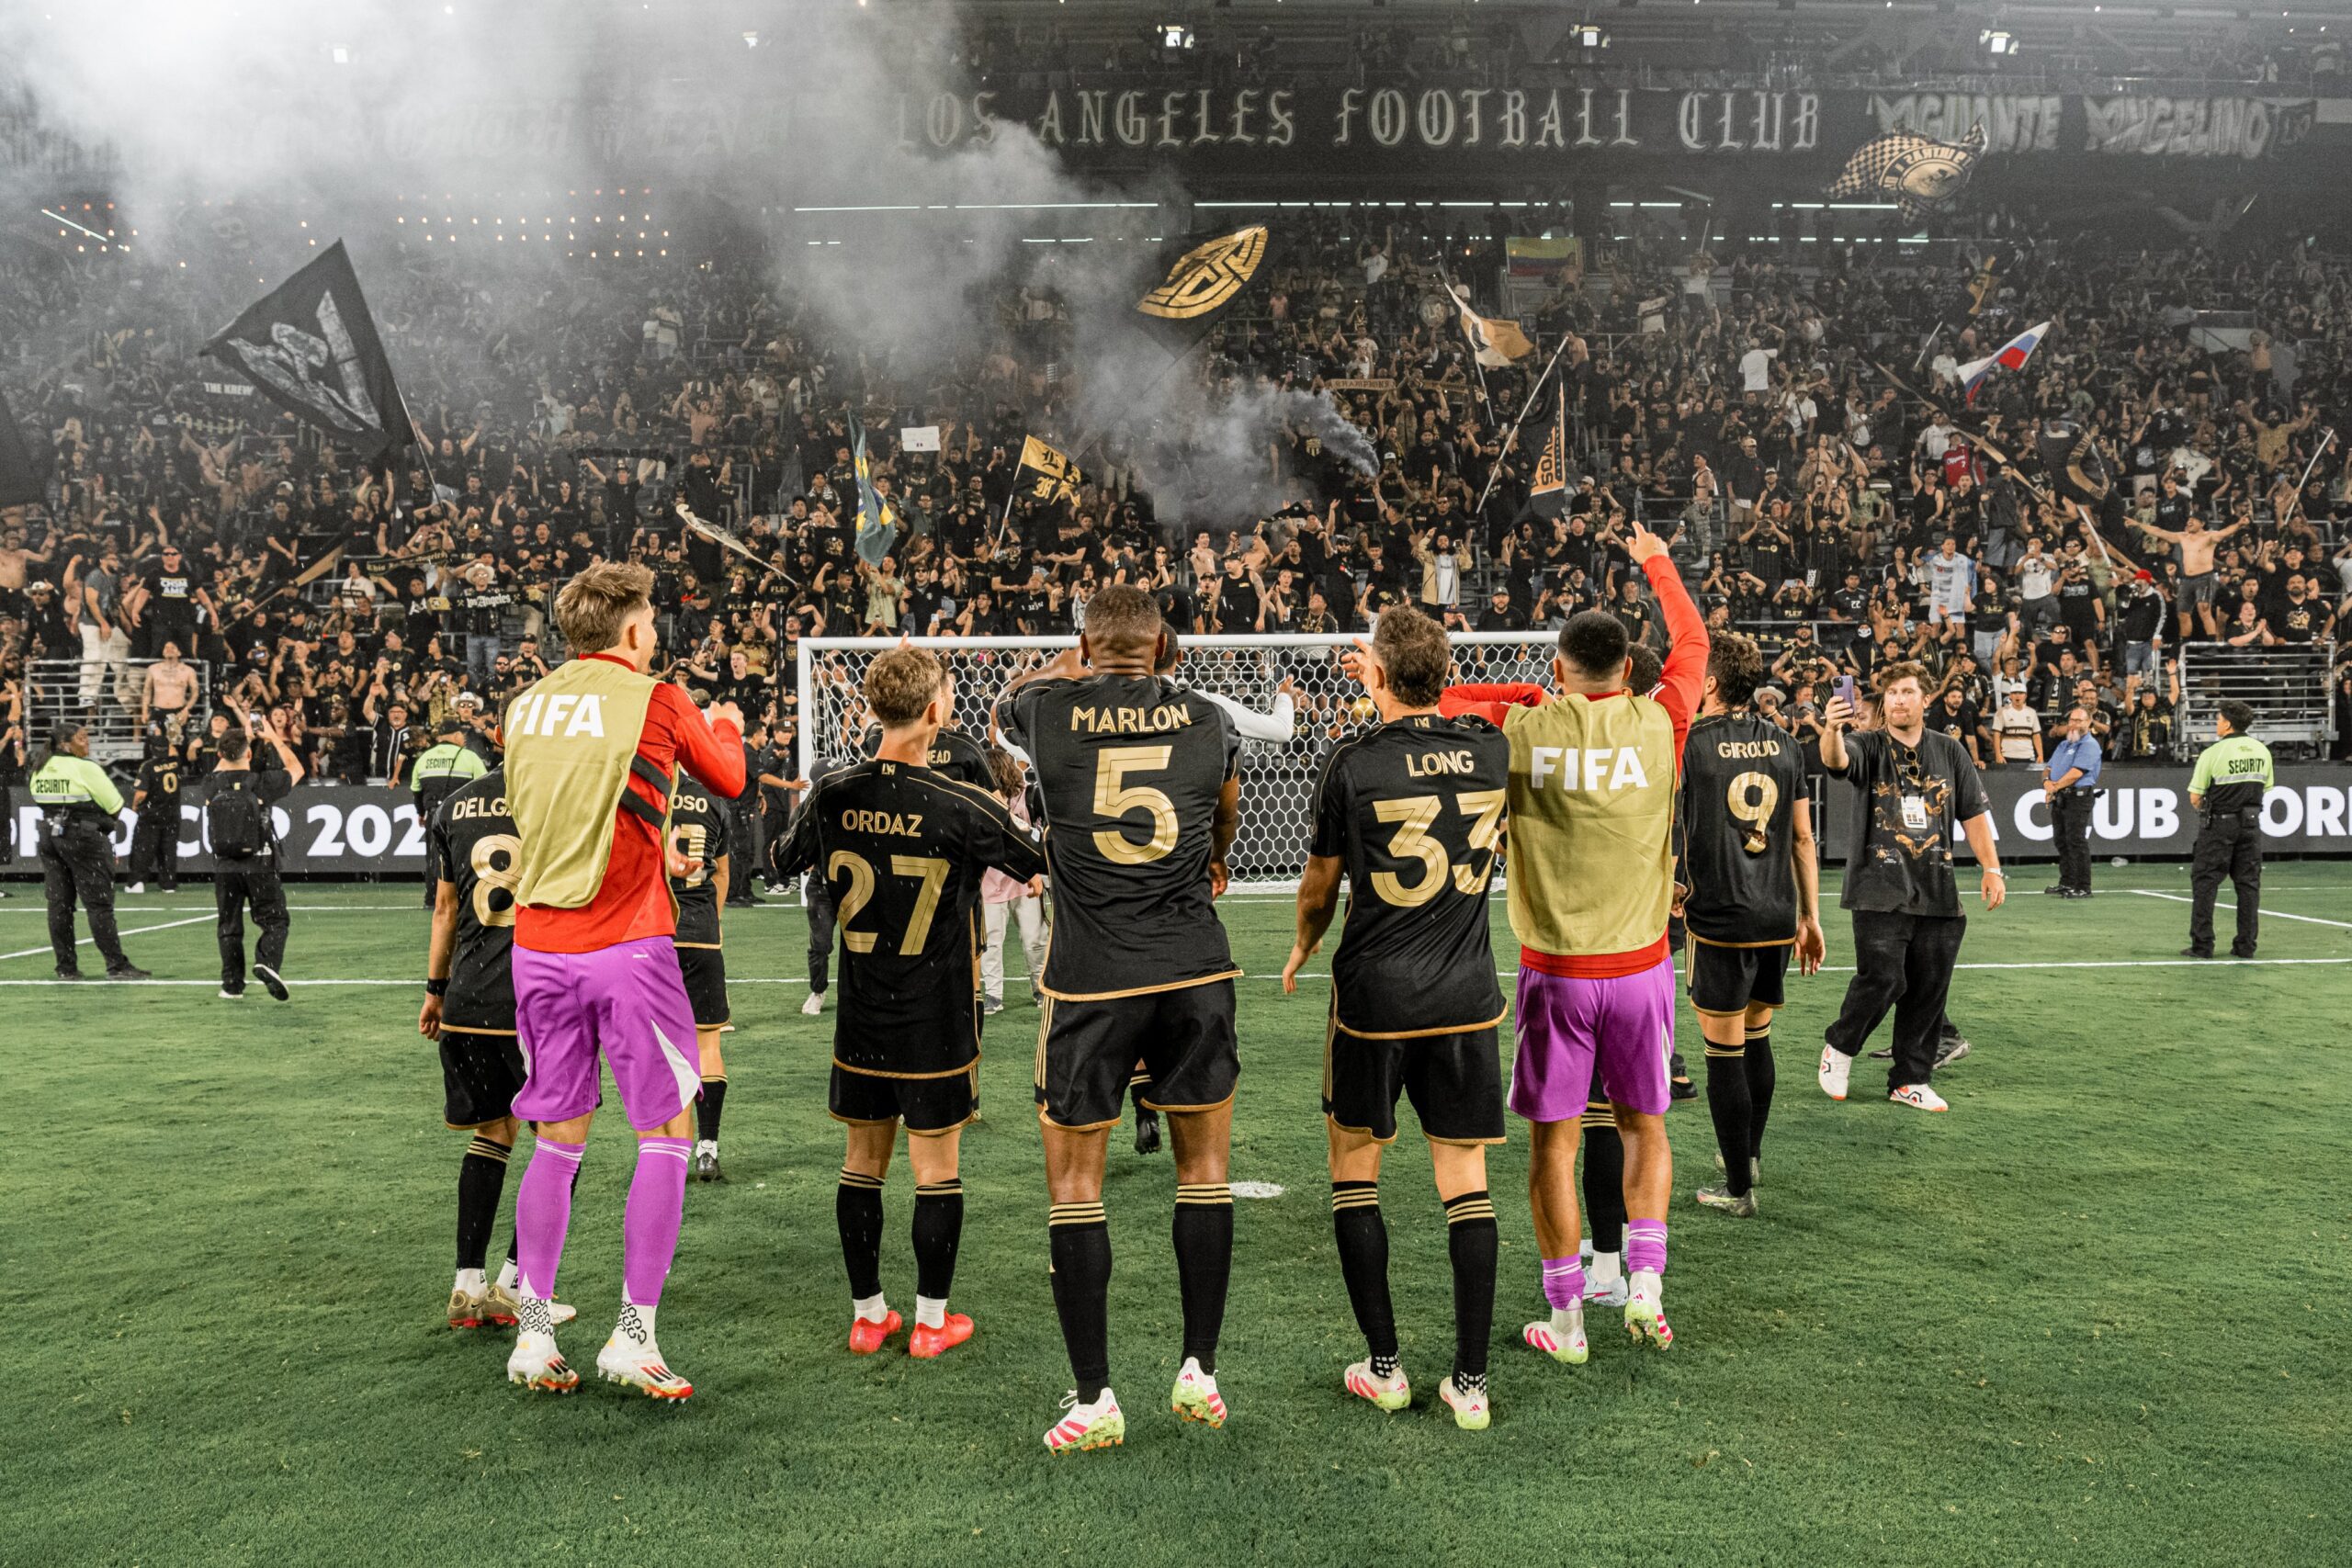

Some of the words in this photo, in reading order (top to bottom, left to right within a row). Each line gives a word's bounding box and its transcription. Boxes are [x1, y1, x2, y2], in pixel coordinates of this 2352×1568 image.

[893, 90, 1000, 154] LOS
[1037, 88, 1295, 147] ANGELES
[1333, 87, 1640, 148] FOOTBALL
[1677, 89, 1820, 152] CLUB
[203, 382, 221, 394] THE
[223, 383, 254, 396] KREW
[477, 593, 511, 608] Angeles
[1784, 609, 1803, 617] FLEX
[1850, 600, 1861, 609] 22
[509, 694, 605, 738] FIFA
[1071, 703, 1193, 734] MARLON
[425, 758, 455, 769] SECURITY
[1407, 750, 1475, 778] LONG
[1718, 739, 1781, 761] GIROUD
[1532, 746, 1650, 791] FIFA
[2229, 758, 2266, 776] SECURITY
[35, 779, 70, 794] SECURITY
[452, 796, 514, 821] DELG
[1091, 745, 1180, 865] 5
[1727, 772, 1780, 853] 9
[2014, 787, 2180, 840] CUB
[307, 805, 428, 858] 202
[842, 809, 922, 838] ORDAZ
[1371, 787, 1507, 908] 33
[470, 833, 523, 928] 8
[828, 850, 951, 956] 27
